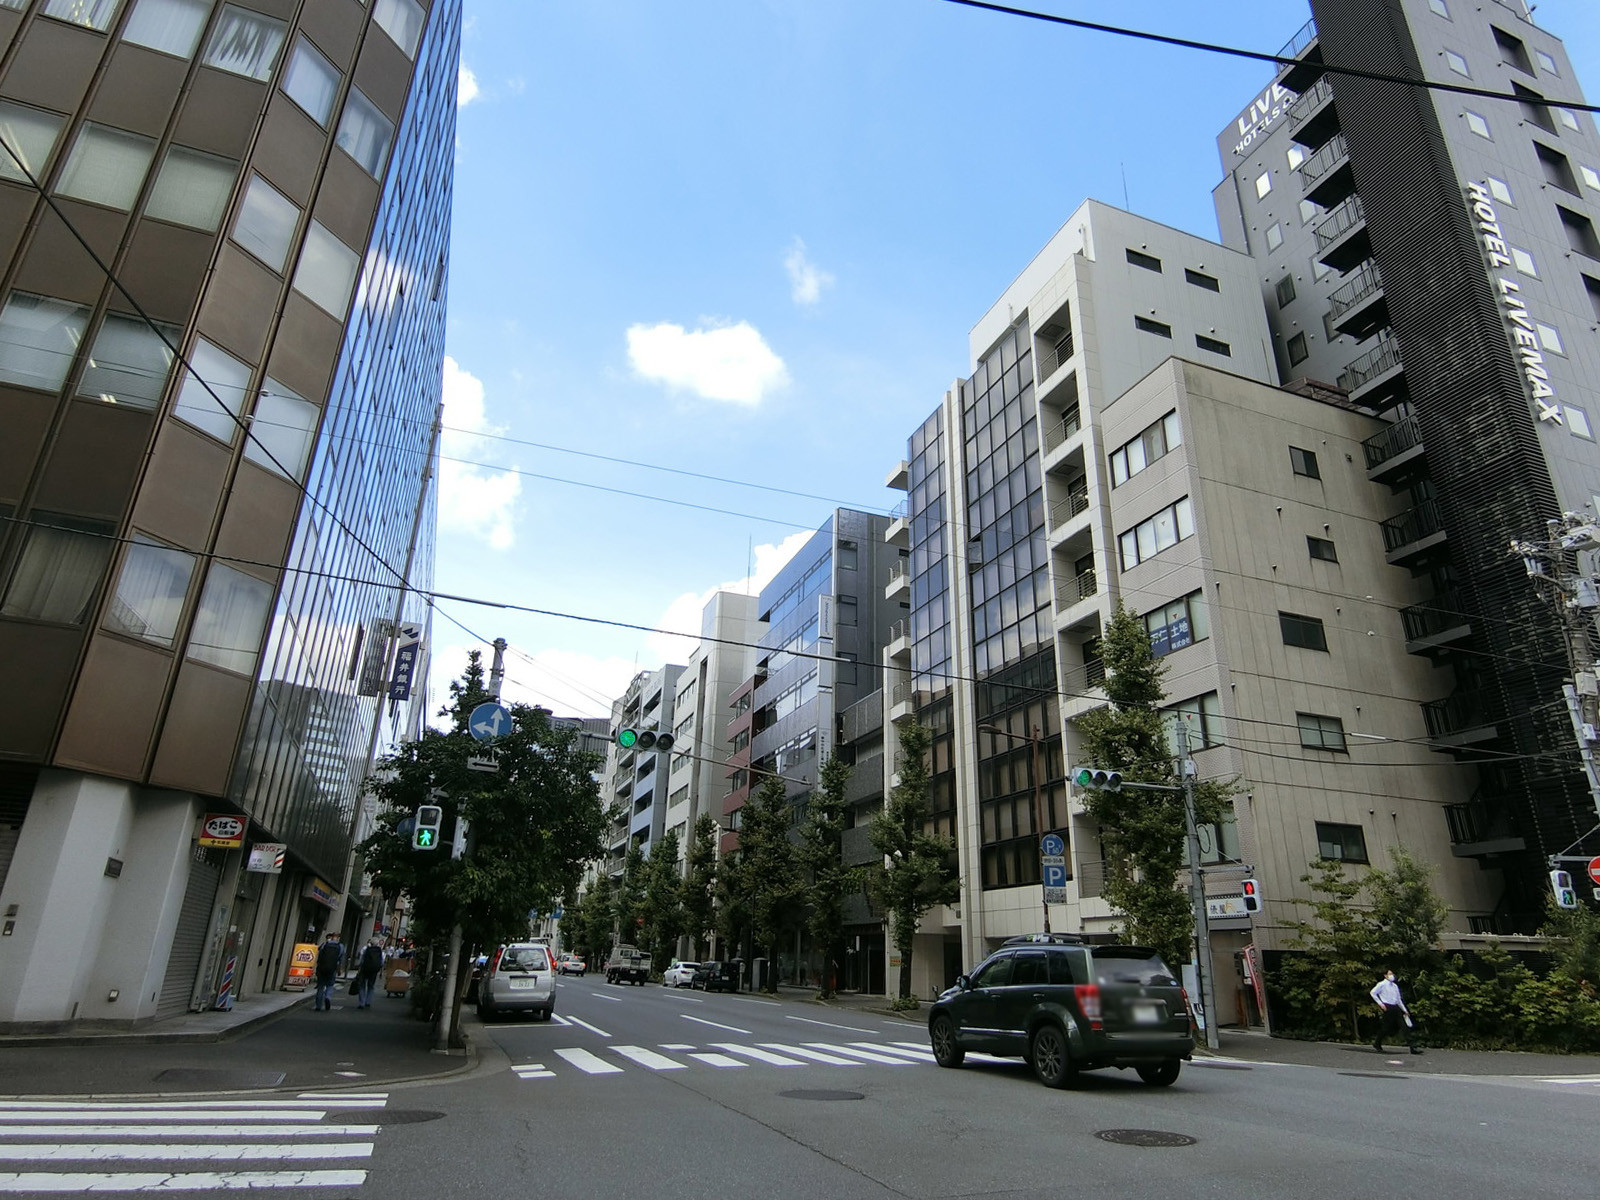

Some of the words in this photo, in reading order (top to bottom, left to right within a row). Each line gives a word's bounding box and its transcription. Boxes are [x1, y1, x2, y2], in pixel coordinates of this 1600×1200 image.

[1232, 106, 1281, 155] HOTELS
[1467, 181, 1511, 268] HOTEL
[394, 651, 412, 695] 福井銀行
[208, 820, 238, 830] たばこ
[1046, 840, 1055, 854] P
[1049, 867, 1062, 885] P
